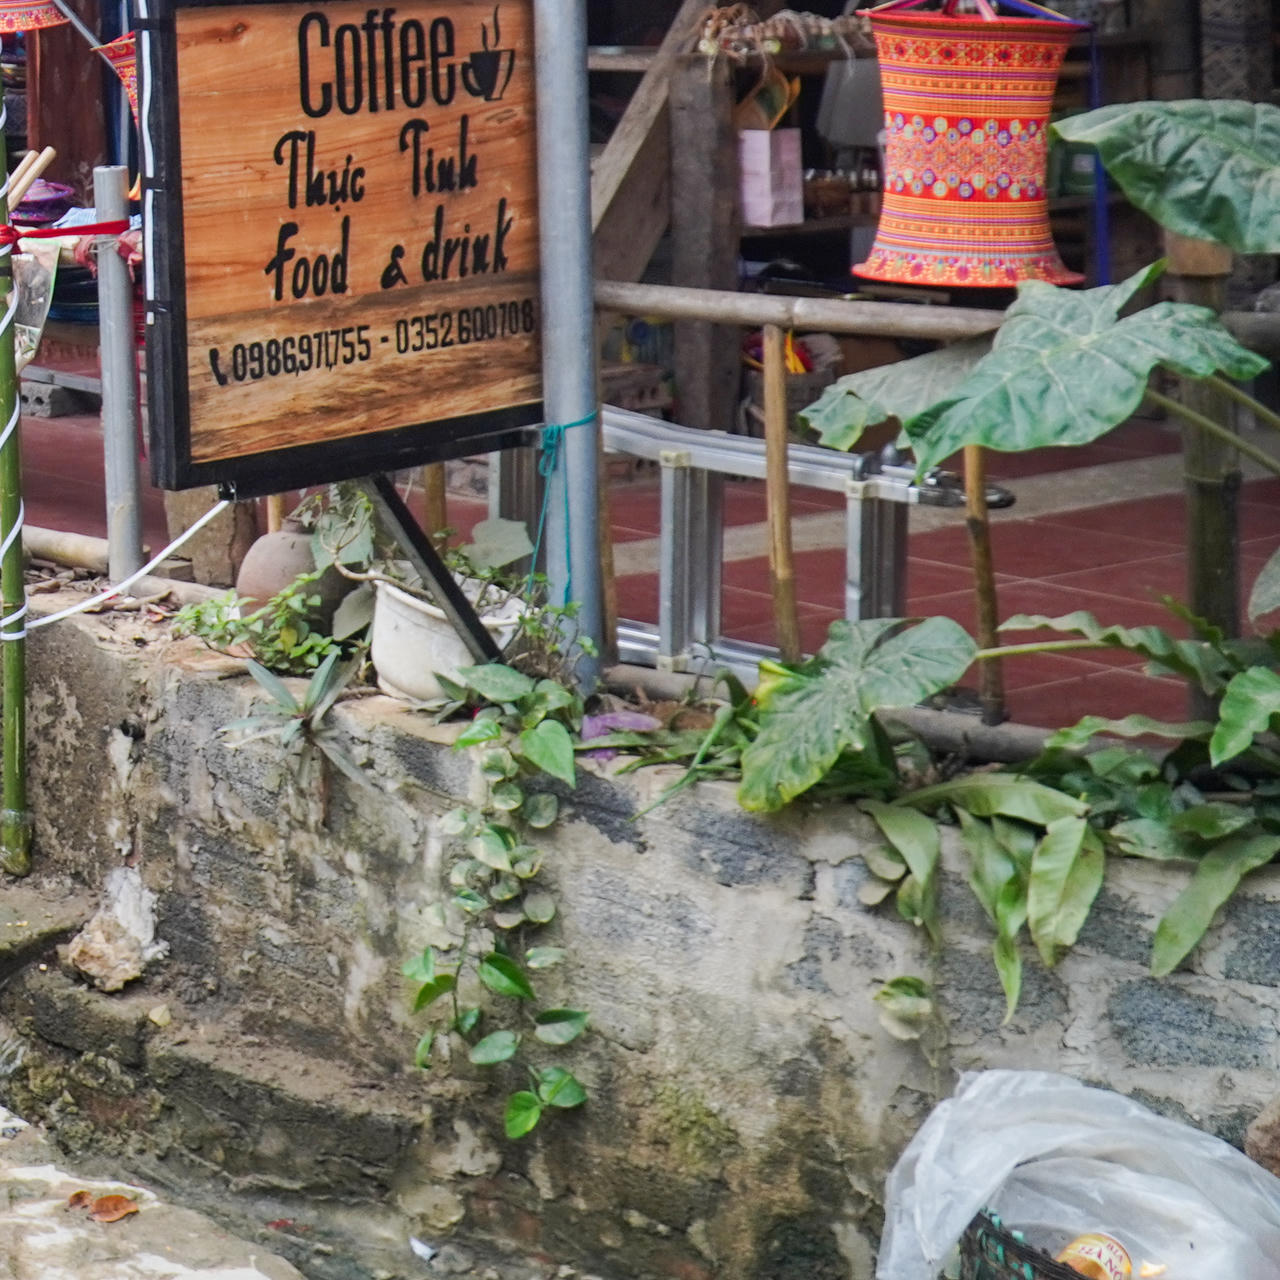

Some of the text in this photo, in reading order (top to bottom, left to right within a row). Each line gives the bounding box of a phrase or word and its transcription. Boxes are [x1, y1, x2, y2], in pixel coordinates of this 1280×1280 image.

[298, 7, 457, 119] Coffee
[380, 244, 409, 290] &
[421, 197, 513, 283] drink
